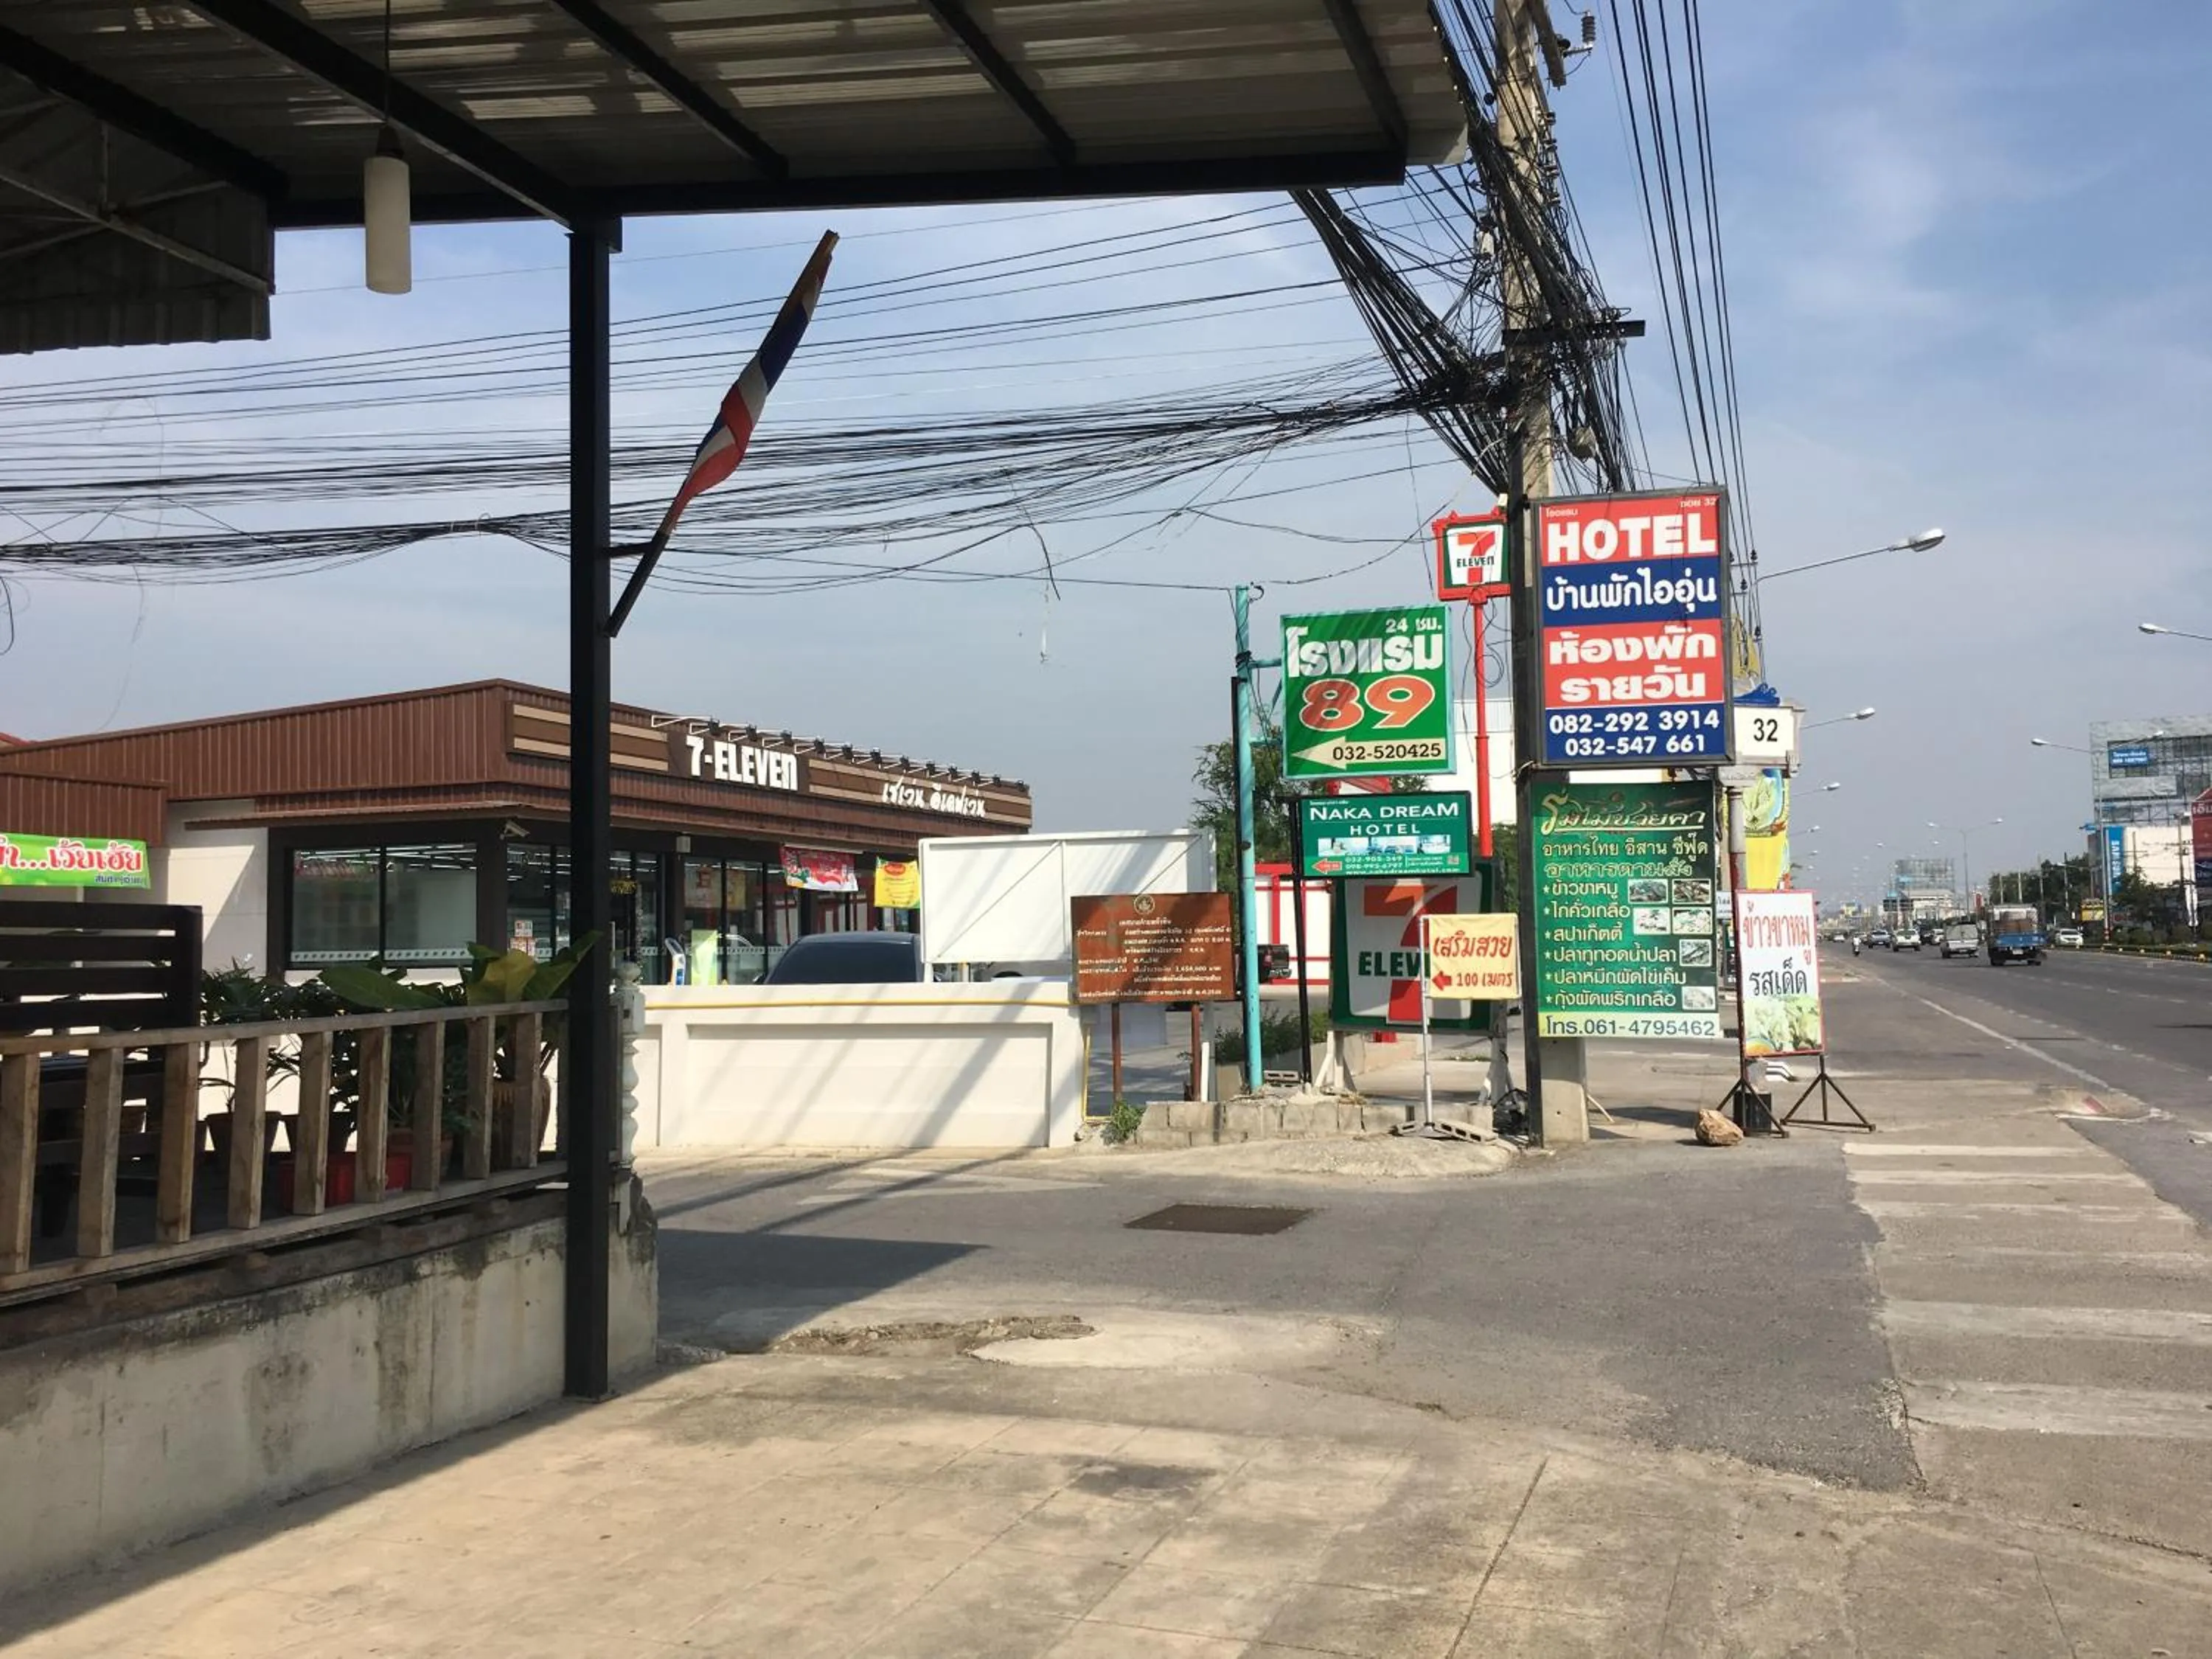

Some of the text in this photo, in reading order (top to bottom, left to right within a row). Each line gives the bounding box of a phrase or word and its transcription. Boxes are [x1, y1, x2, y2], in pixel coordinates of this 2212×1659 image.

[1548, 512, 1717, 563] HOTEL
[1546, 567, 1717, 613] บ้านพักไออุ่น
[1385, 618, 1408, 633] 24
[1285, 625, 1444, 678] โรงแรม
[1549, 625, 1717, 664] ห้องพัก
[1560, 664, 1706, 703] รายวัน
[1298, 674, 1436, 732] 89
[1549, 709, 1720, 734] 082-292 3914
[1753, 717, 1778, 742] 32
[1332, 742, 1442, 761] 032-520425
[1565, 734, 1705, 757] 032-547 661
[882, 775, 925, 809] เซเว่น
[1310, 801, 1459, 821] NAKA DREAM
[1350, 824, 1422, 836] HOTEL
[1543, 835, 1619, 856] อาหารไทย
[1624, 837, 1668, 856] อีสาน
[1552, 880, 1618, 900] ข้าวขาหมู
[1552, 900, 1631, 919] ไก่คั่วเกลือ
[1433, 930, 1513, 958] เสริมสวย
[1743, 901, 1811, 964] ข้าวขาหมู
[1553, 942, 1677, 967] ปลาทูทอดน้ำปลา
[1456, 973, 1514, 987] 100 เมตร
[1554, 967, 1687, 986] ปลาหมึกผัดไข่เค็ม
[1749, 956, 1808, 995] รสเด็ด
[1554, 988, 1677, 1009] กุ้งผัดพริกเกลือ
